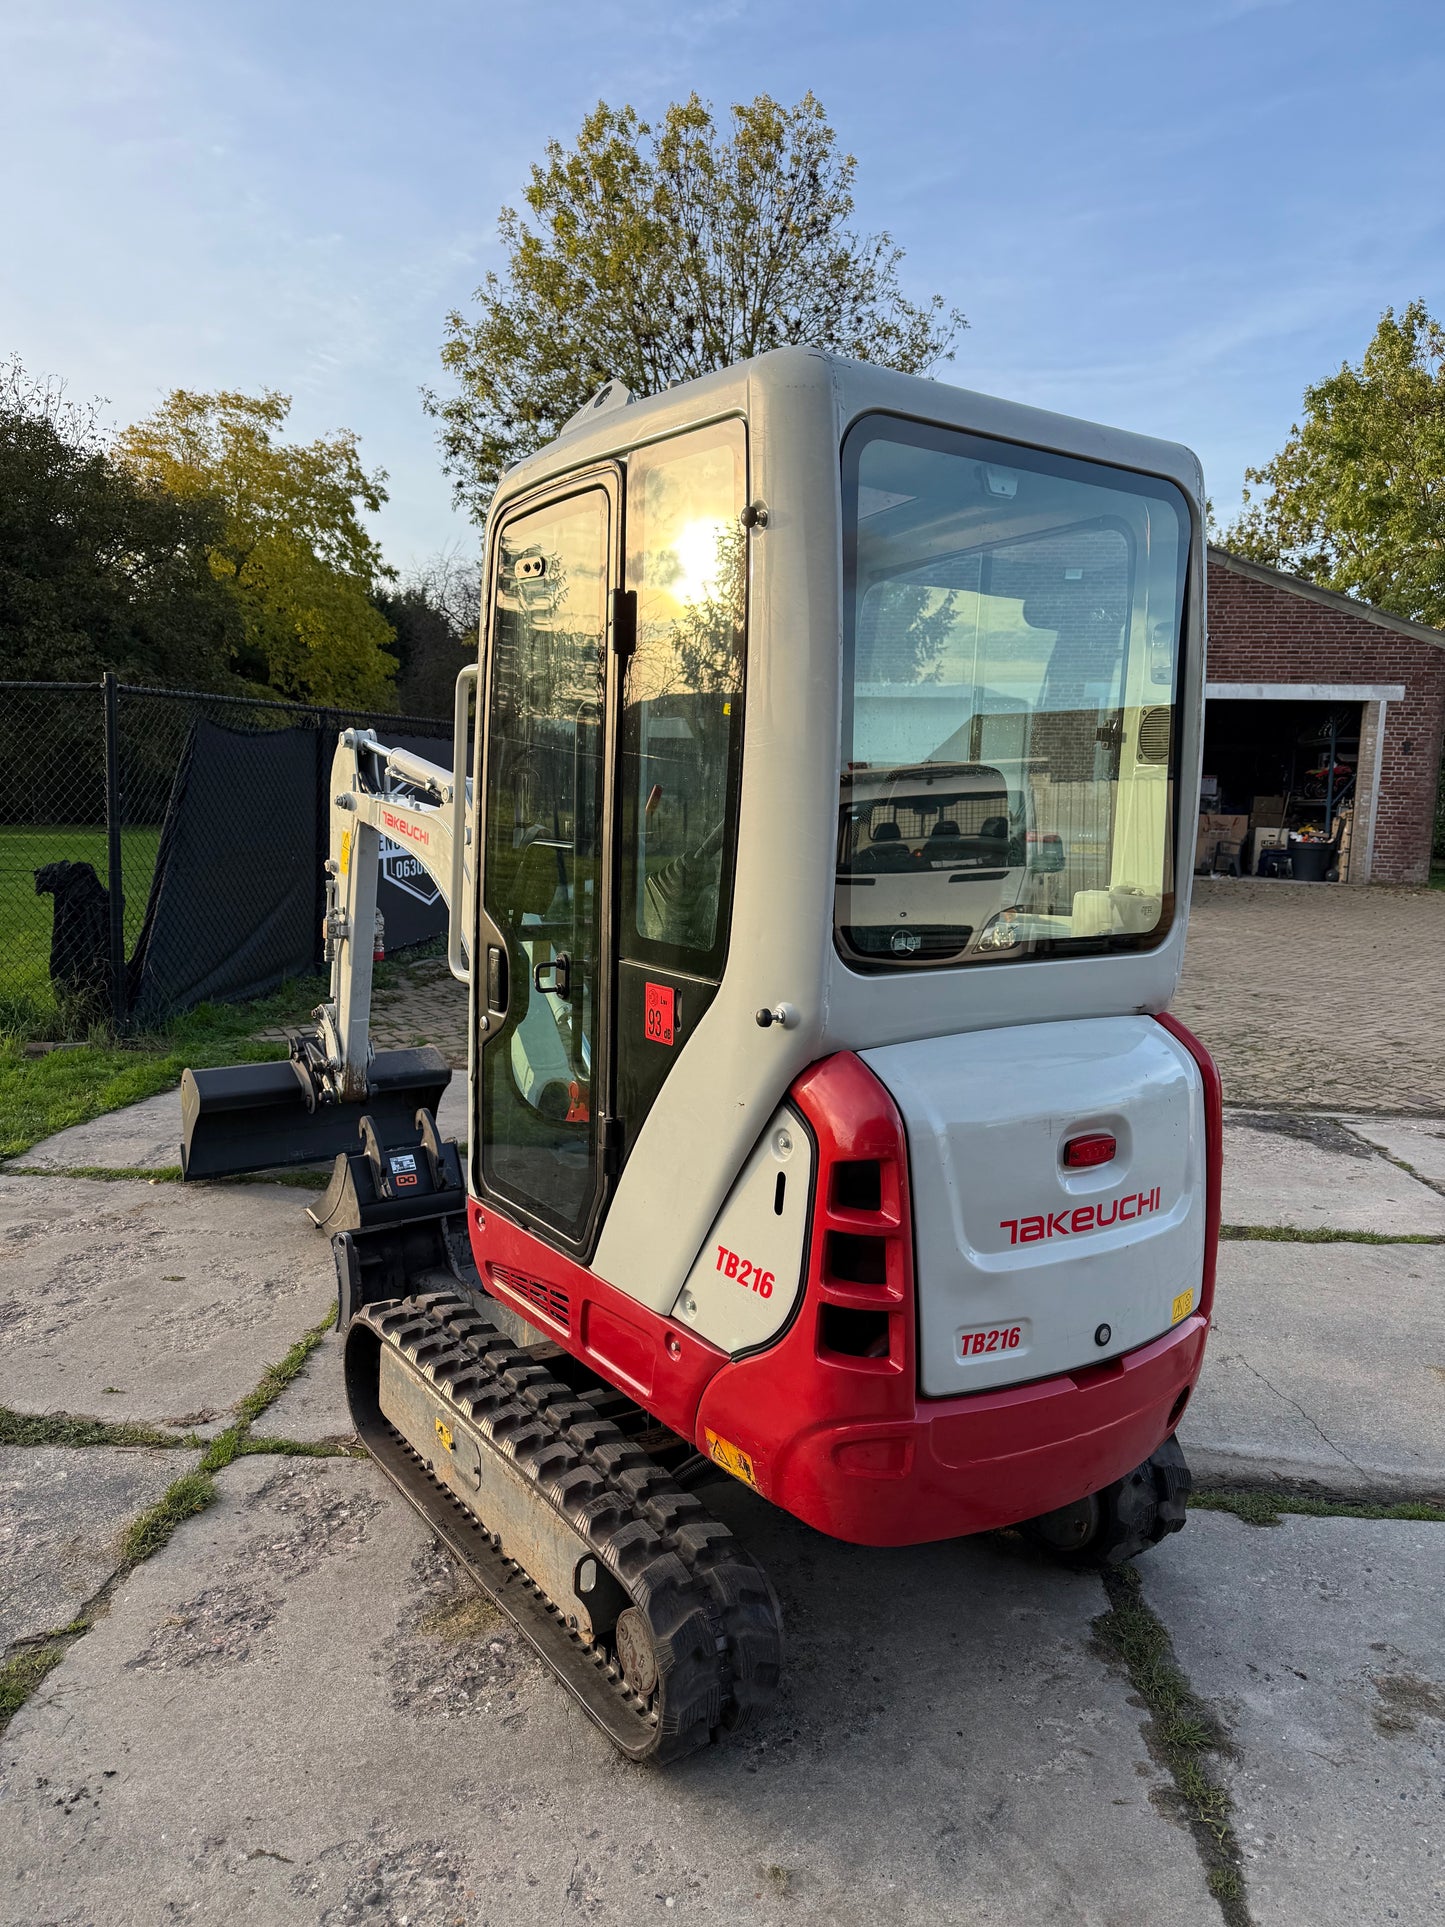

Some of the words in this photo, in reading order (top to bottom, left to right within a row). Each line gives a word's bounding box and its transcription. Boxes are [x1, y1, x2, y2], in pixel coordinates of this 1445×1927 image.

[648, 1008, 662, 1037] 93
[663, 1028, 671, 1040] dB
[1000, 1187, 1162, 1245] TAKEUCHI
[715, 1245, 776, 1299] TB216
[961, 1327, 1021, 1357] TB216
